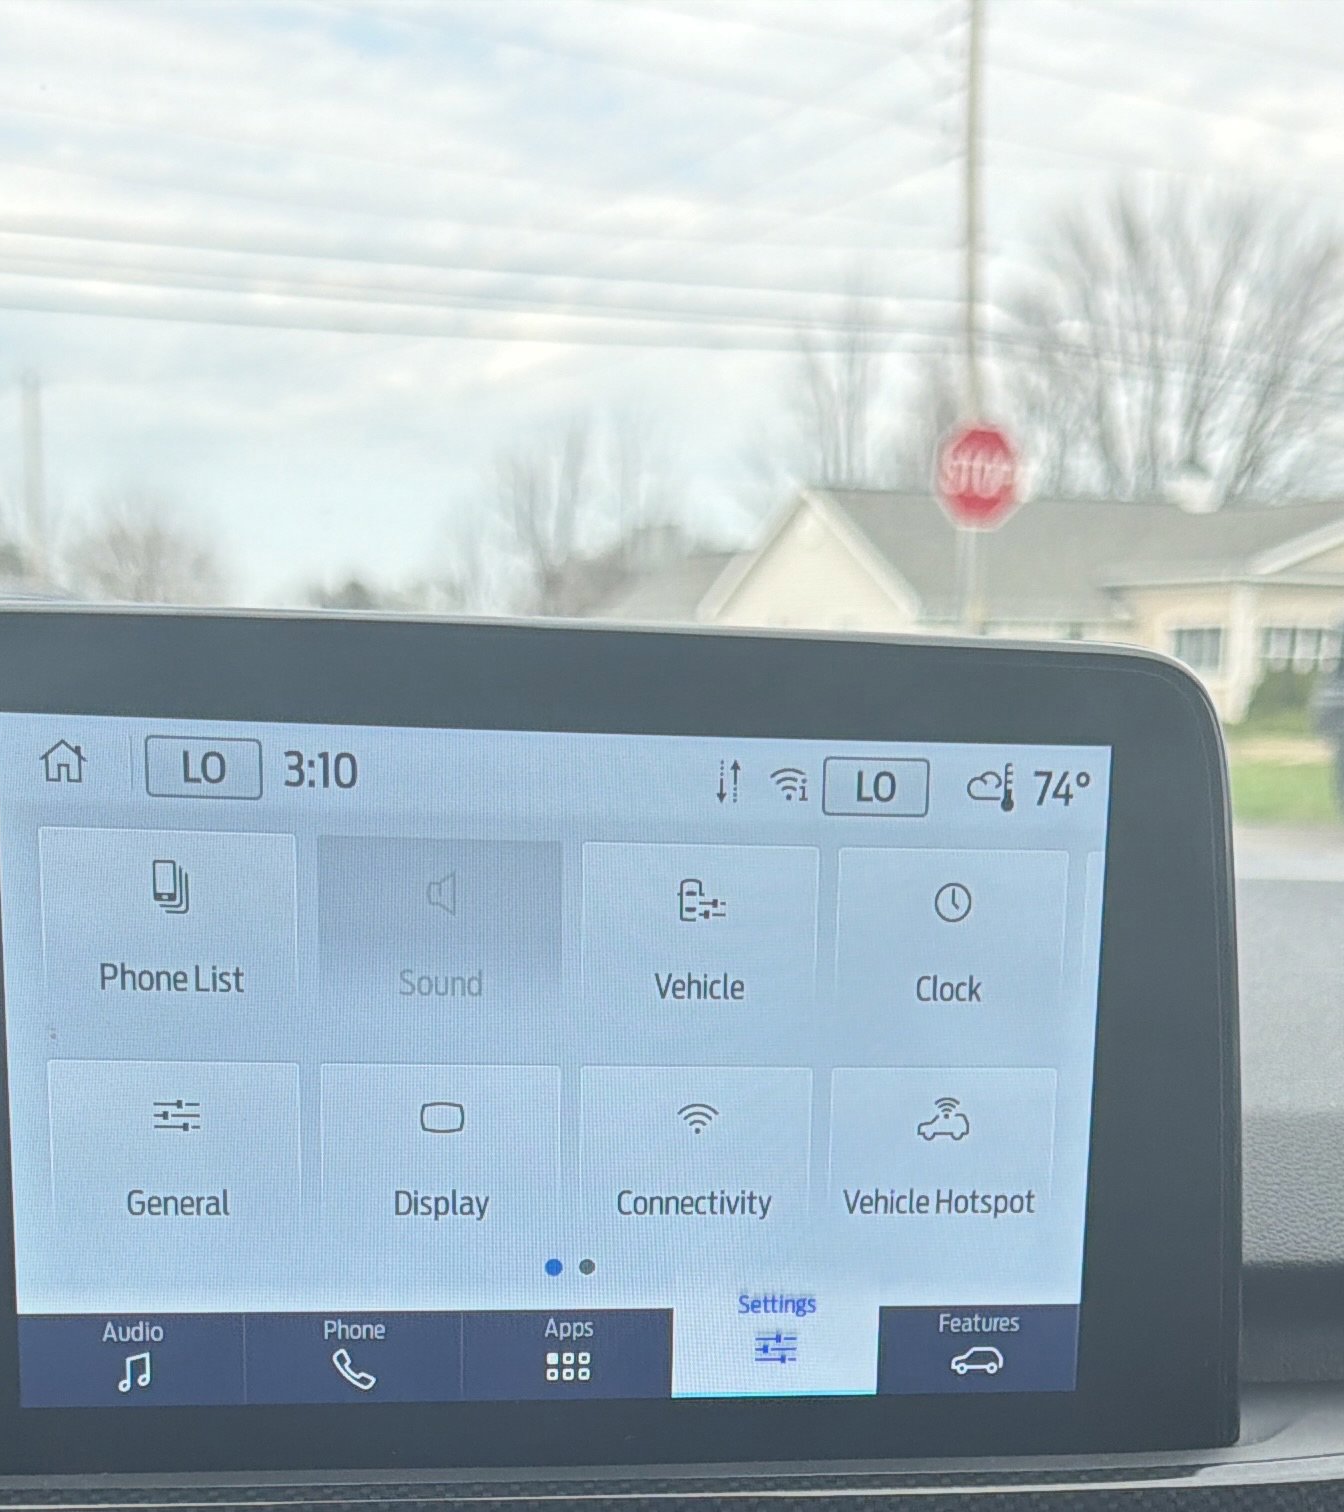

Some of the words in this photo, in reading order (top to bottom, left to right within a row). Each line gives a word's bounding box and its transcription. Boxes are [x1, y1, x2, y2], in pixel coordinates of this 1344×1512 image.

[183, 751, 227, 784] LO
[284, 752, 358, 788] 3:10
[856, 771, 896, 803] LO
[100, 962, 187, 994] Phone
[194, 965, 244, 994] List
[398, 969, 484, 998] Sound
[655, 972, 746, 1002] Vehicle
[916, 976, 982, 1003] Clock
[126, 1188, 231, 1218] General
[393, 1188, 490, 1222] Display
[616, 1188, 773, 1222] Connectivity
[843, 1187, 928, 1217] Vehicle
[936, 1187, 1036, 1220] Hotspot
[737, 1291, 817, 1318] Settings
[102, 1319, 164, 1345] Audio
[323, 1317, 386, 1343] Phone
[544, 1315, 594, 1344] Apps
[938, 1310, 1020, 1336] Features
